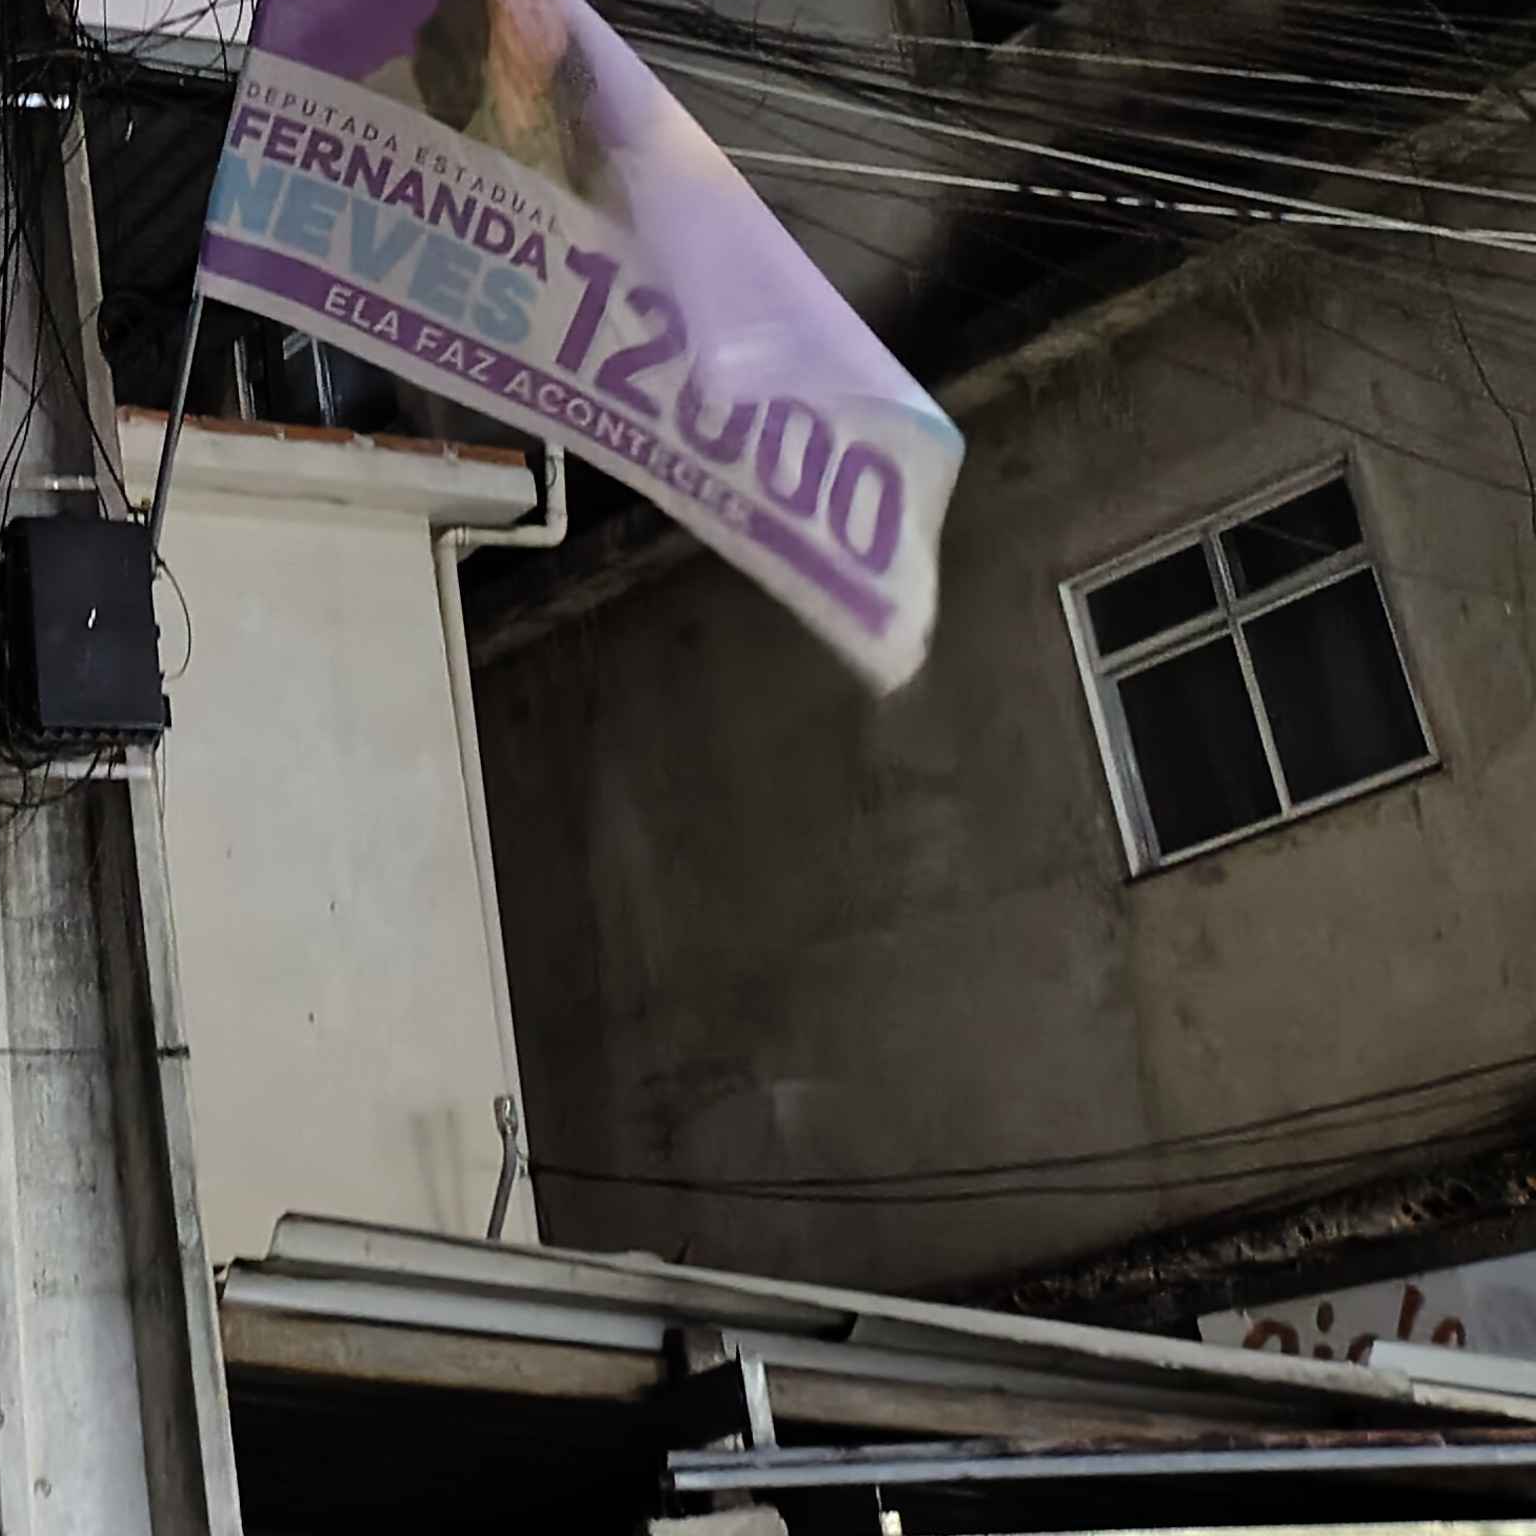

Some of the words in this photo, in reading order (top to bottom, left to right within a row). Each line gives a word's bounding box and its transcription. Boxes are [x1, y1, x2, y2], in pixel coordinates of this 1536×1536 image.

[208, 149, 539, 345] NEVES
[230, 105, 548, 283] FERNANDA
[247, 81, 399, 151] DEPUTADA
[415, 147, 563, 235] ESTADUAL
[324, 284, 400, 340] ELA
[416, 325, 497, 382] FAZ
[555, 244, 903, 575] 12000
